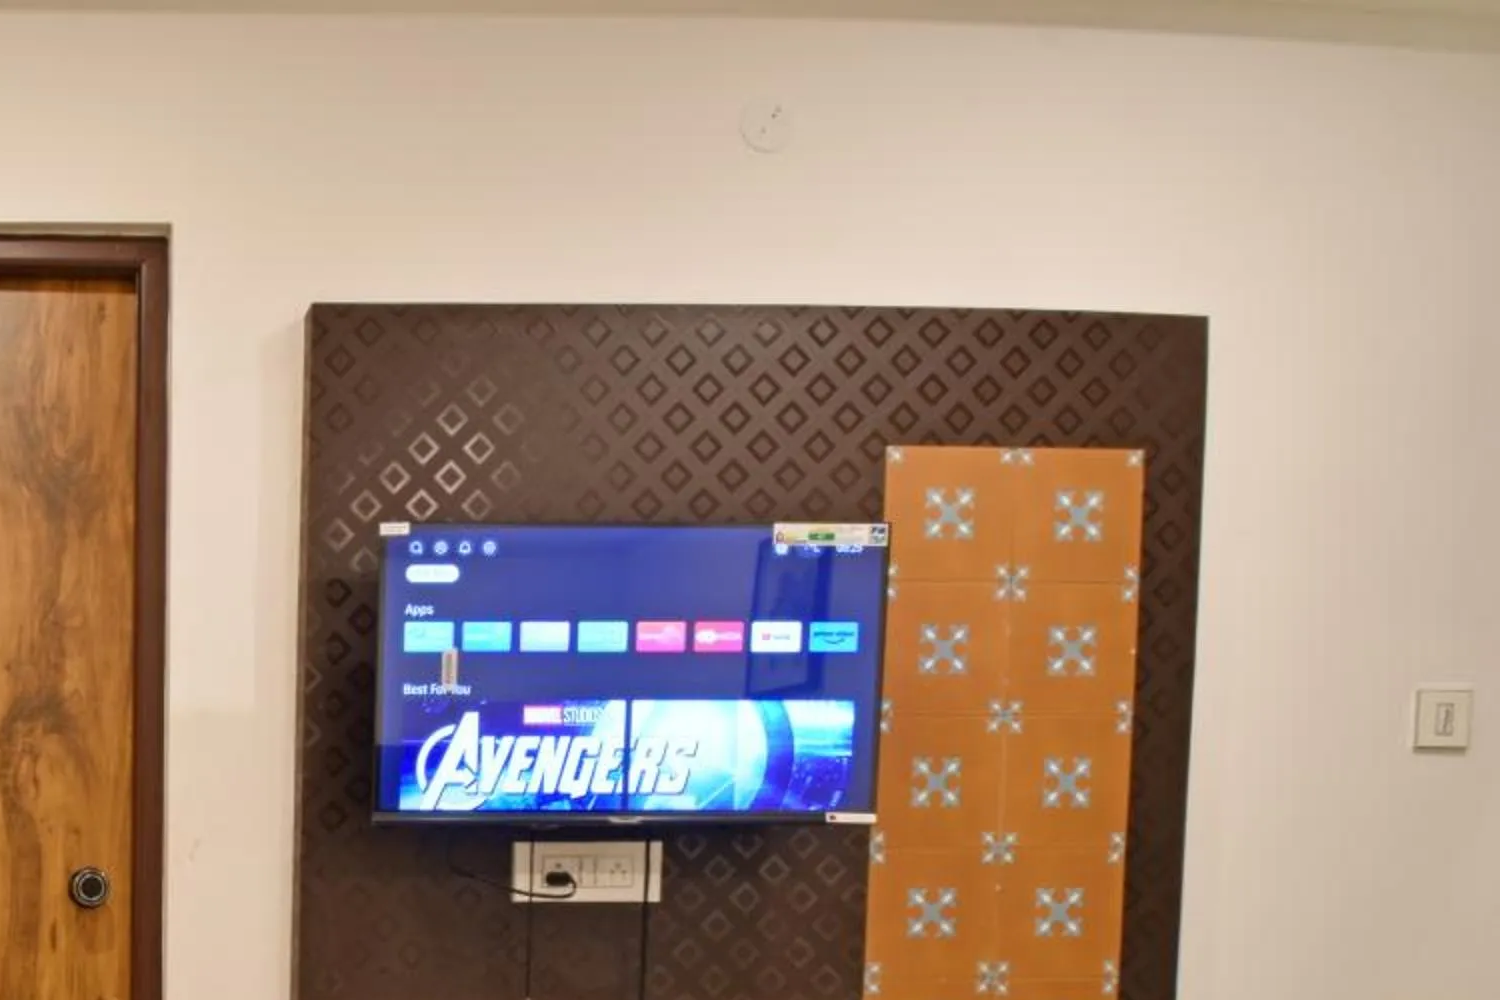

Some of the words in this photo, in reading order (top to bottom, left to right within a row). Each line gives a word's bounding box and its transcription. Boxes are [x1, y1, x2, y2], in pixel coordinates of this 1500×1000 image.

[404, 603, 435, 617] Apps
[403, 683, 428, 695] Best
[416, 711, 698, 810] AVENGERS
